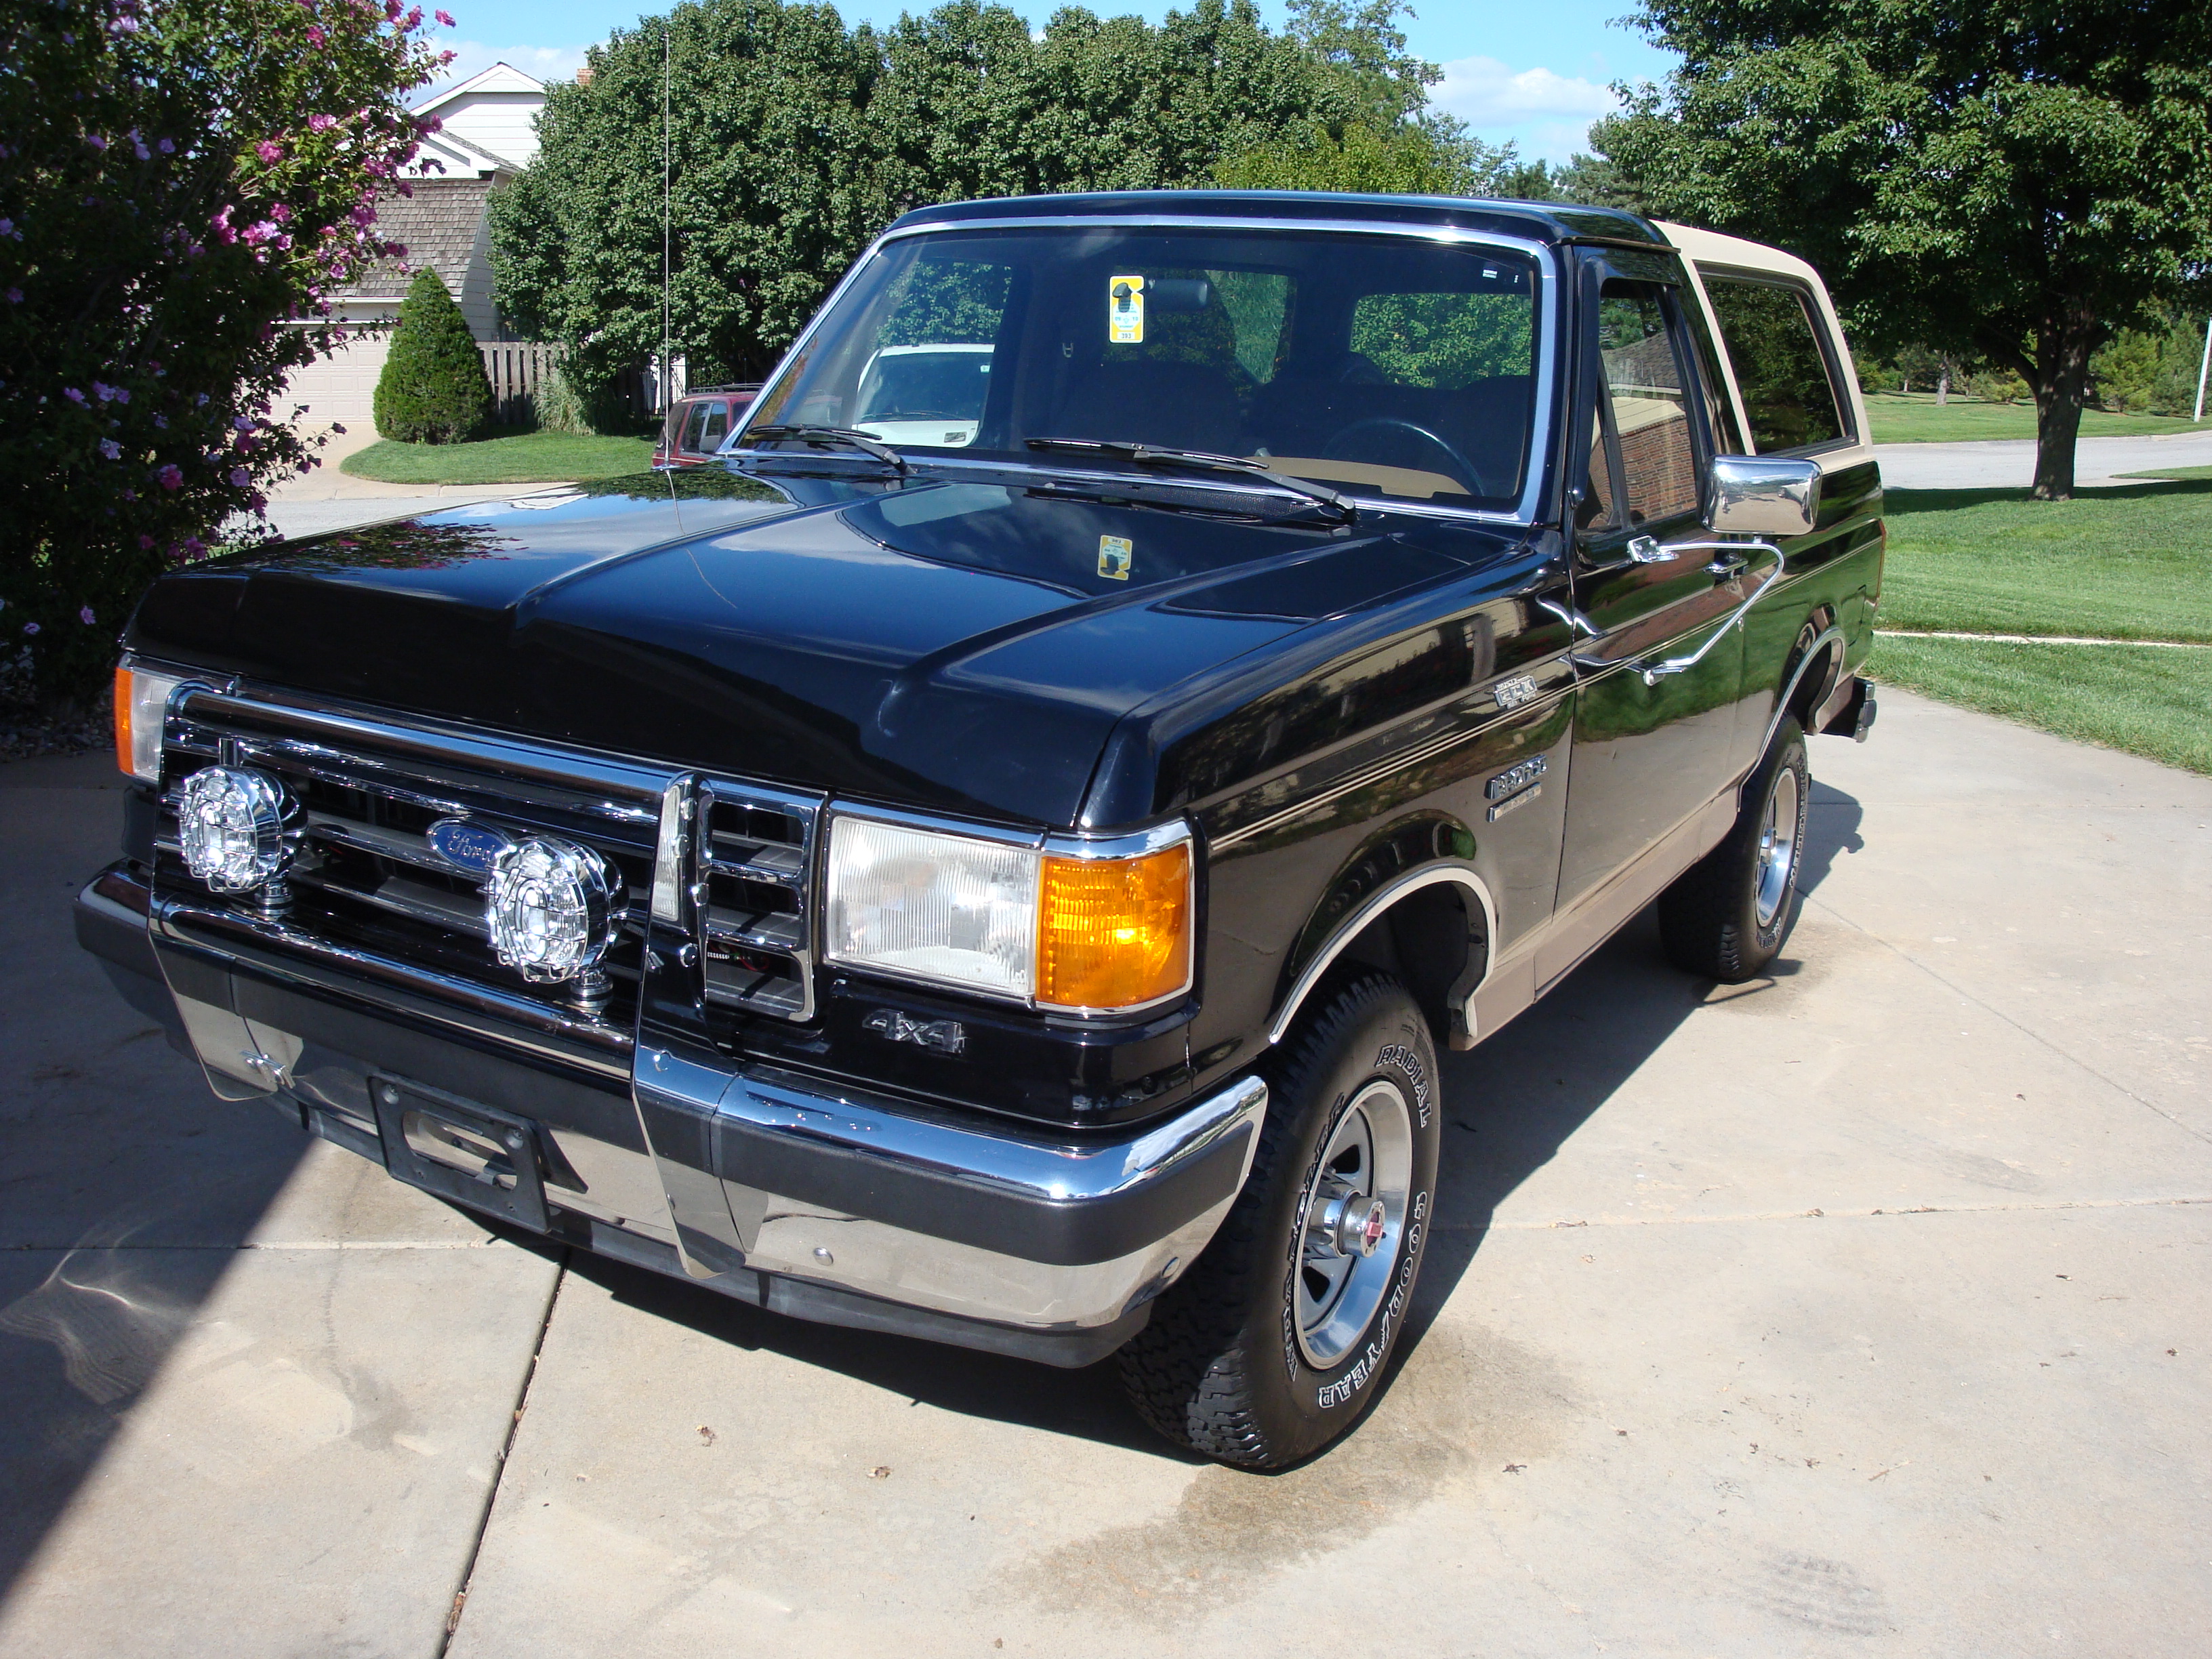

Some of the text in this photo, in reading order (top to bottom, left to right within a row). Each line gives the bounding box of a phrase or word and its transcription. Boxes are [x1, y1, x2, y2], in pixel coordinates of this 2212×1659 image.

[447, 829, 495, 862] Ford
[1375, 1043, 1433, 1129] RADIAL
[1317, 1191, 1428, 1410] GOODYEAR
